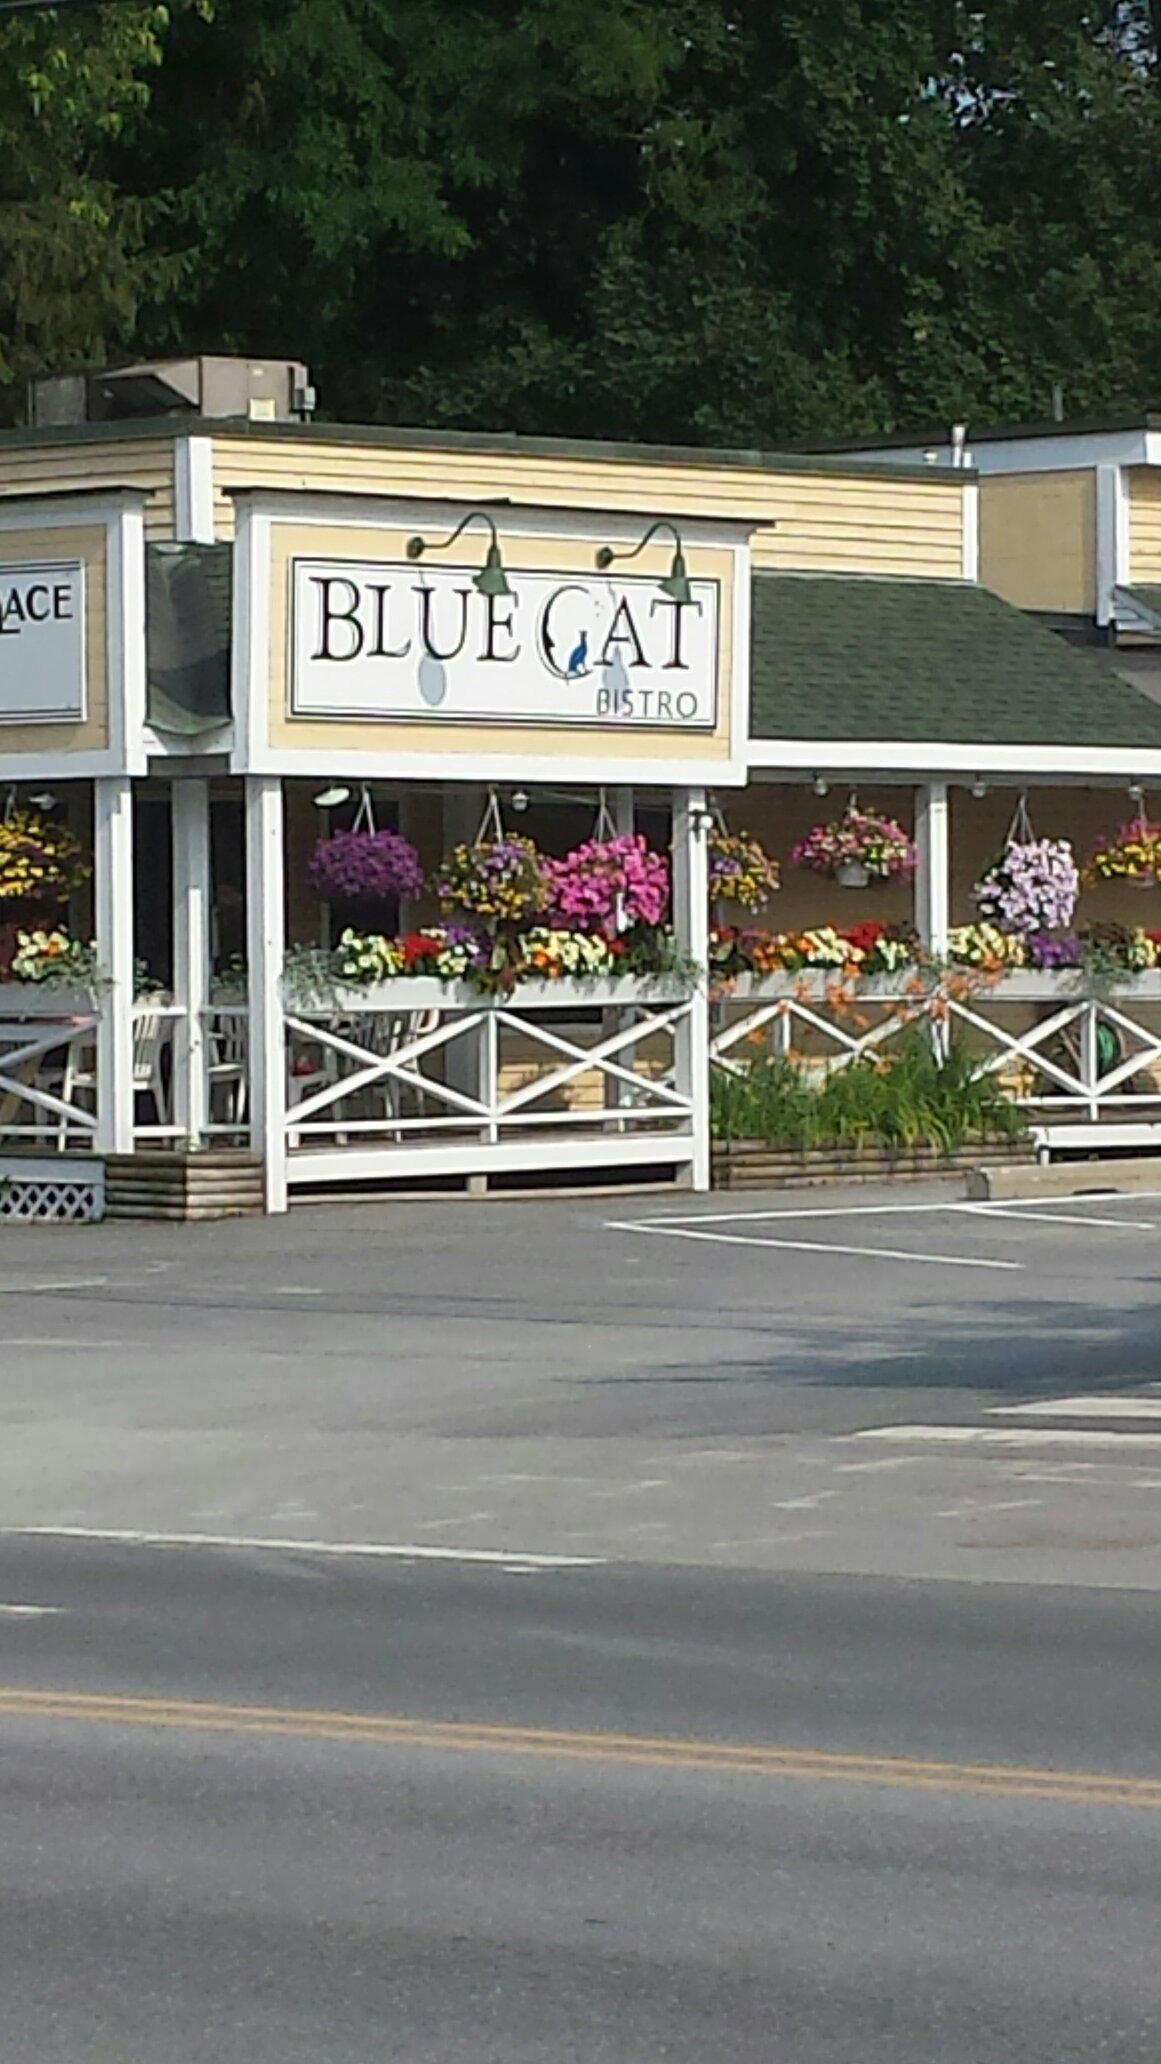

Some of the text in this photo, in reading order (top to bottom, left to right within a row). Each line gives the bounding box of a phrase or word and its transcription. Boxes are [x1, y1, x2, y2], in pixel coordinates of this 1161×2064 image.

[310, 576, 703, 680] BLUE CAT
[596, 688, 698, 719] BISTRO
